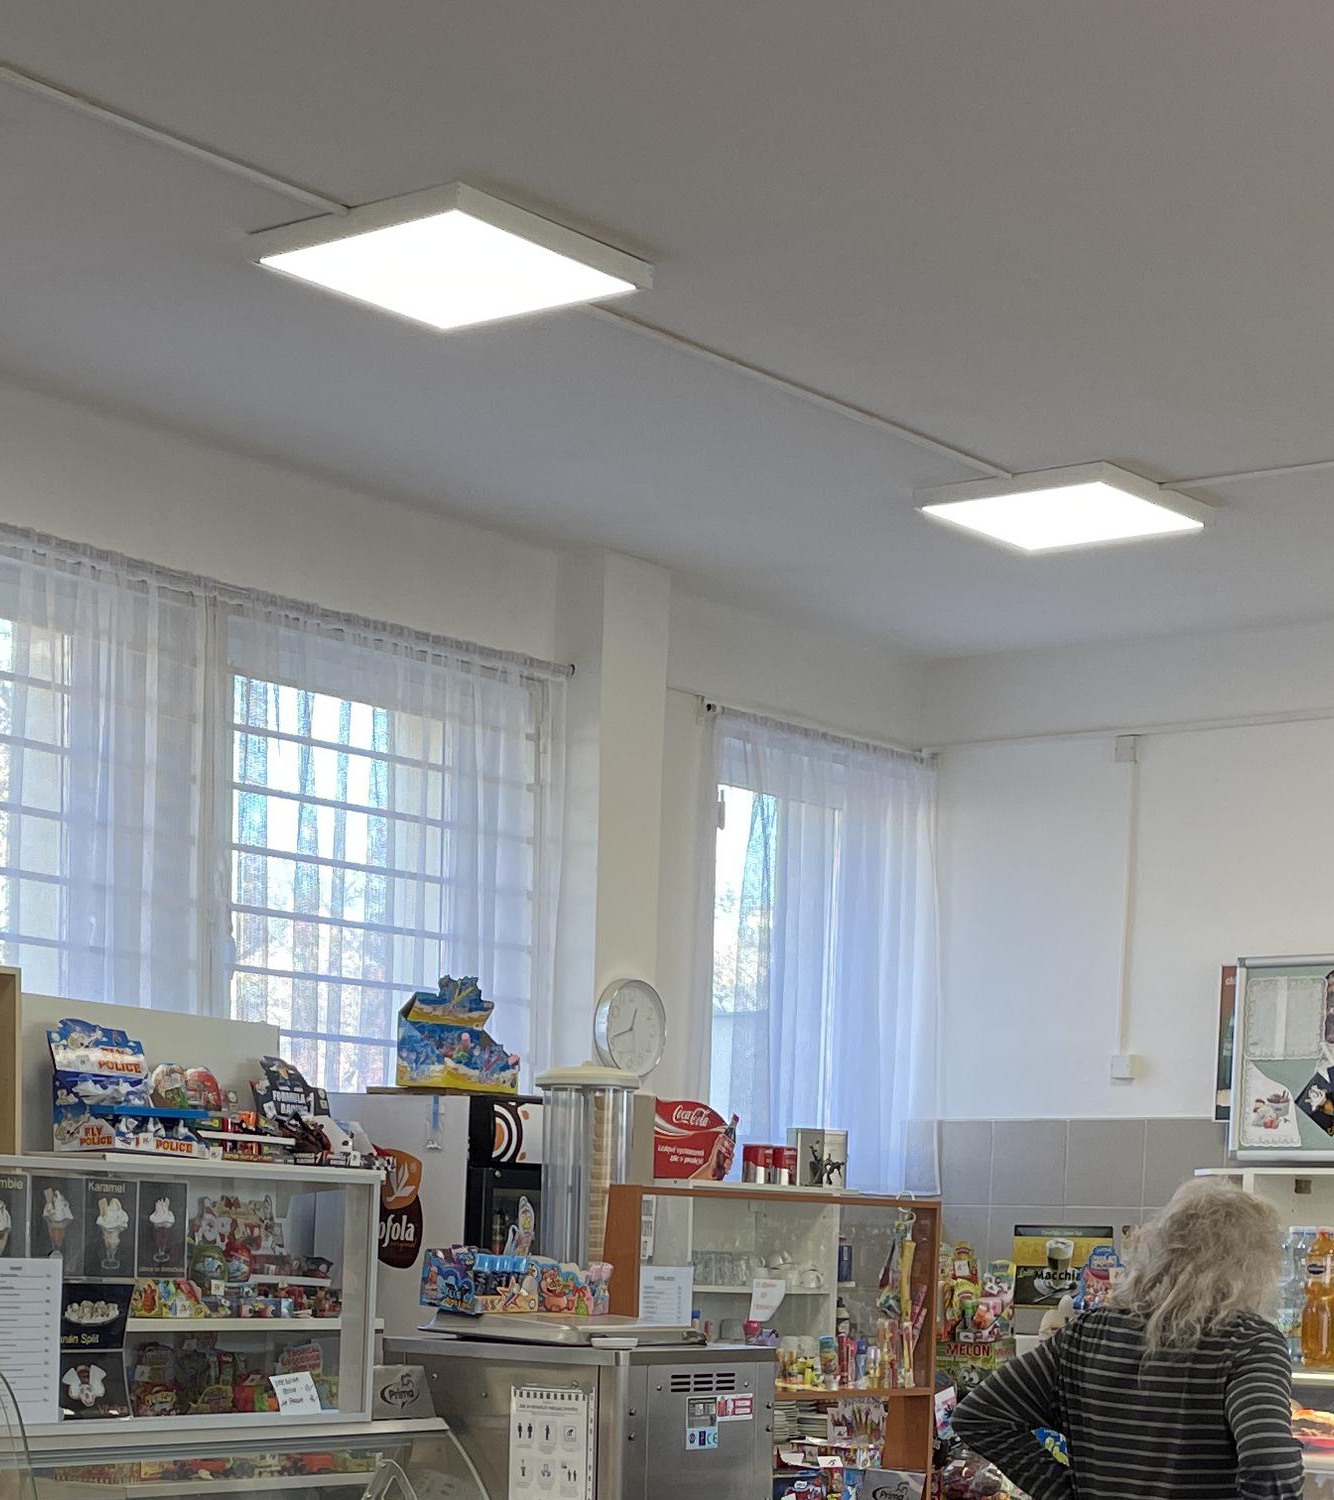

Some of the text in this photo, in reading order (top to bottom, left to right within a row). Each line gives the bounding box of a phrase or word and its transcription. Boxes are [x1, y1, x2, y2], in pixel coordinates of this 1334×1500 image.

[98, 1060, 142, 1074] POLICE
[155, 1139, 194, 1154] POLICE
[88, 1180, 126, 1194] Karamel
[379, 1214, 415, 1248] ofola
[947, 1343, 991, 1357] MELON
[389, 1388, 415, 1400] Prima
[879, 1489, 904, 1500] Prima
